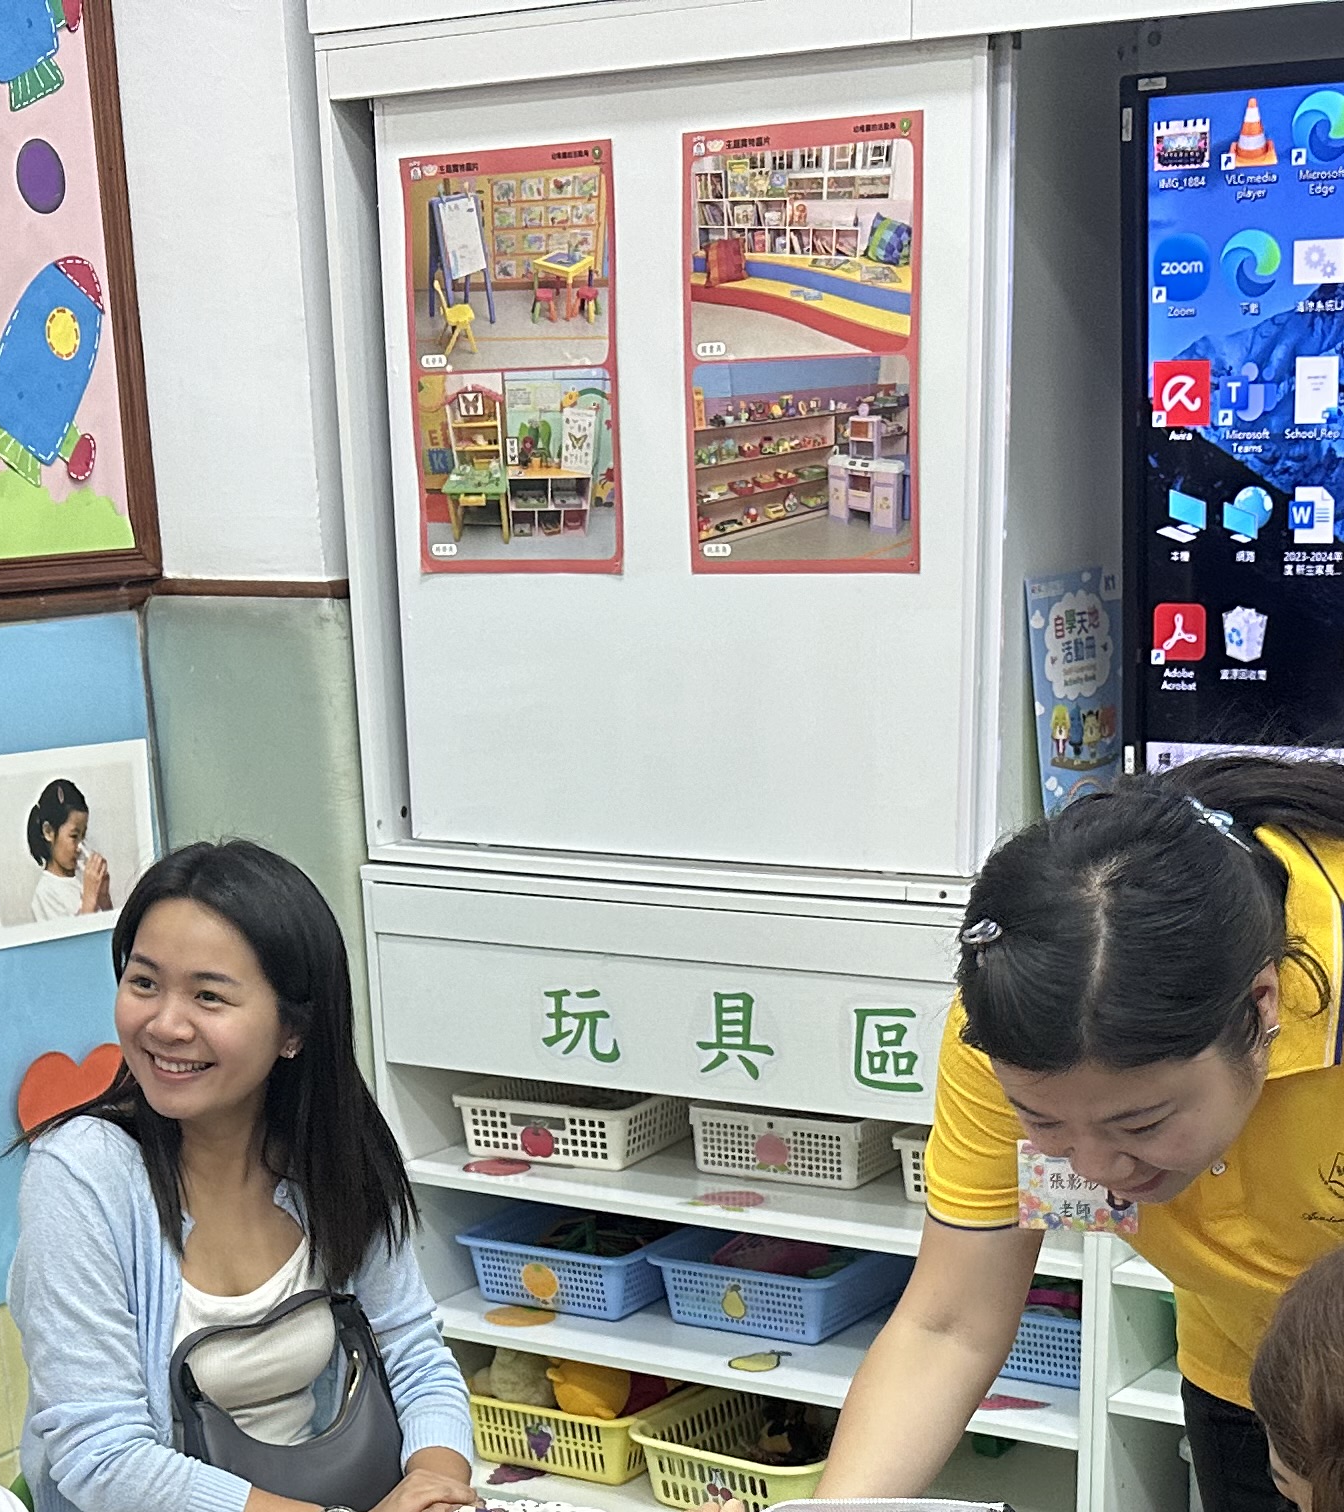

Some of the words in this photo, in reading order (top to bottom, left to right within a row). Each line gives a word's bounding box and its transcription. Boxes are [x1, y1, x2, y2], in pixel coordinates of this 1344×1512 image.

[1225, 174, 1245, 186] VLC
[1246, 172, 1278, 185] media
[1236, 188, 1267, 203] player
[1308, 183, 1335, 197] Edge
[1161, 261, 1204, 276] zoom
[1167, 305, 1196, 318] Zoom
[1169, 430, 1193, 442] Avira
[1226, 427, 1271, 441] Microsoft
[1231, 441, 1263, 454] Teams
[1163, 667, 1195, 680] Adobe
[1161, 679, 1197, 693] Acrobat
[542, 986, 925, 1094] 玩具區
[1058, 1200, 1091, 1219] 老師
